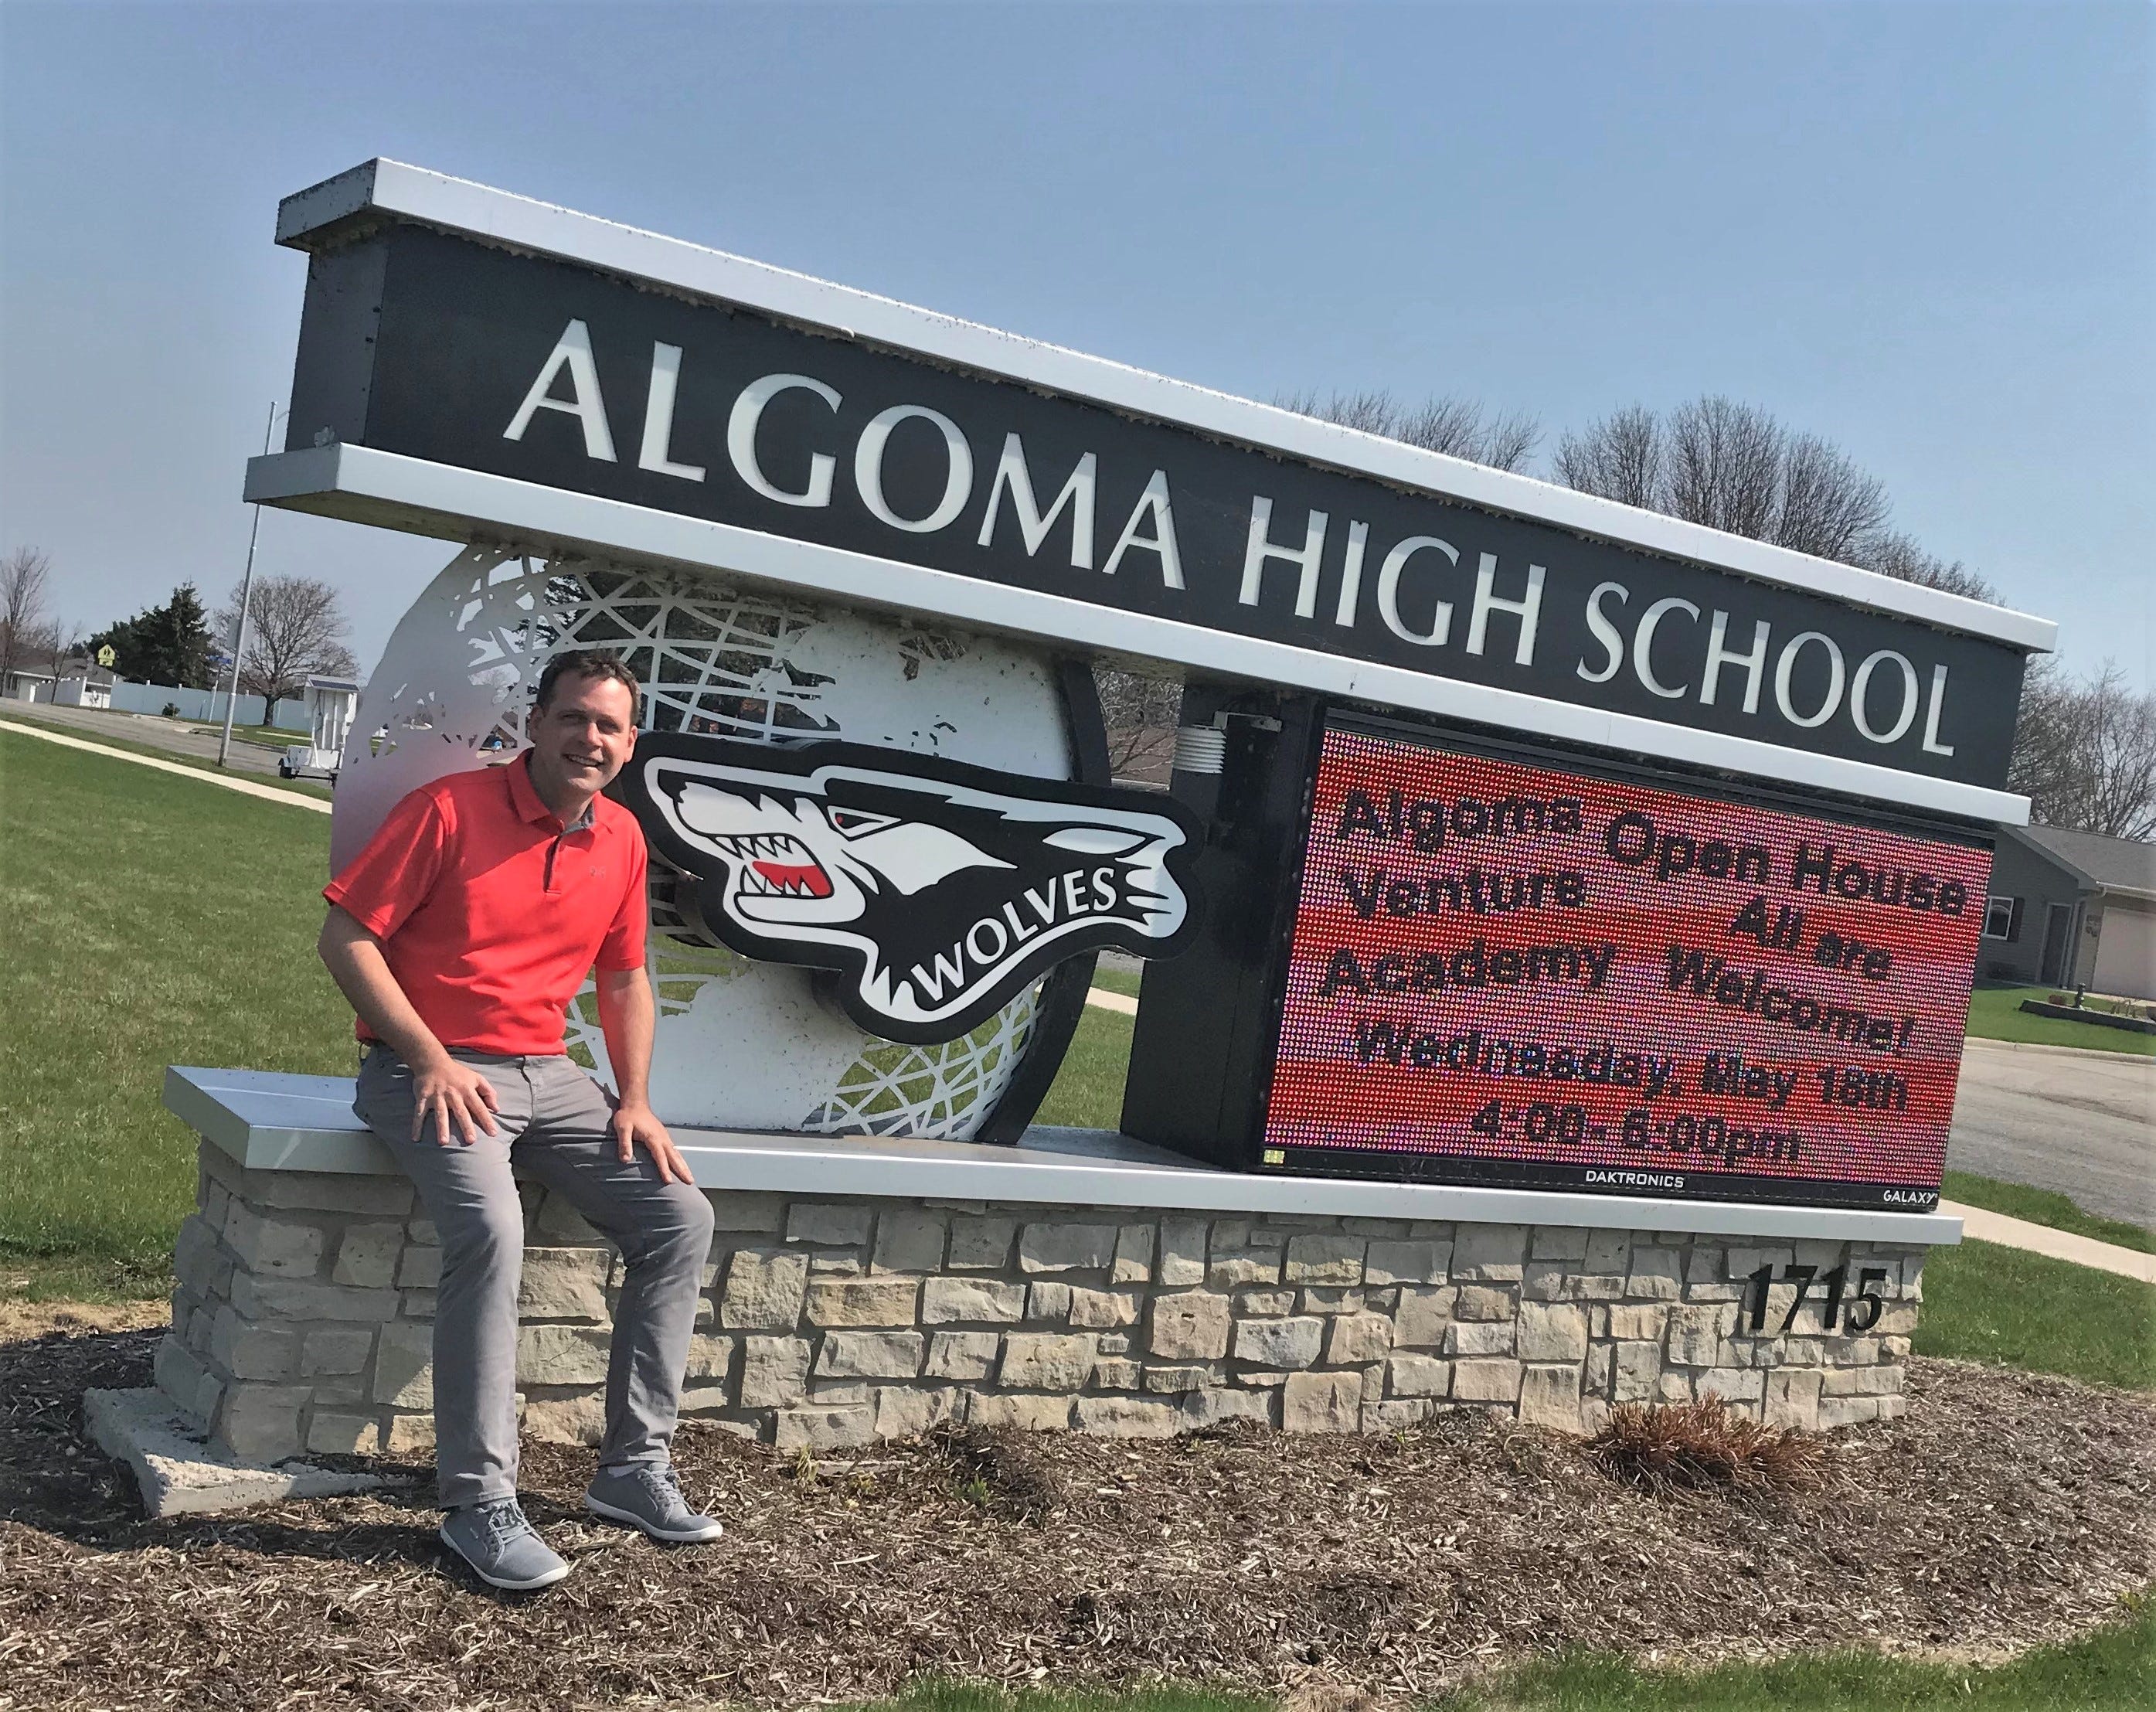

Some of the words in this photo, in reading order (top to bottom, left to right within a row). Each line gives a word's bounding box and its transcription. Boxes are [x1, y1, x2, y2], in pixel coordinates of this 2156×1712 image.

[503, 317, 1187, 591] ALGOMA
[1238, 495, 1546, 666] HIGH
[1576, 580, 1954, 757] SCHOOL
[1337, 790, 1583, 853] Algoma
[1341, 869, 1586, 919] Venture
[1605, 812, 1768, 881] Open
[1791, 842, 1967, 916] House
[910, 867, 1117, 1002] WOLVES
[1318, 938, 1615, 996] Academy
[1728, 893, 1804, 951] All
[1814, 932, 1892, 981] are
[1667, 942, 1915, 1052] Welcome!
[1354, 1019, 1682, 1099] Wednesday,
[1702, 1050, 1798, 1111] May
[1815, 1064, 1910, 1111] 18th
[1586, 1170, 1685, 1189] DAKTRONICS
[1883, 1190, 1936, 1204] GALAXY
[1748, 1263, 1887, 1331] 1715
